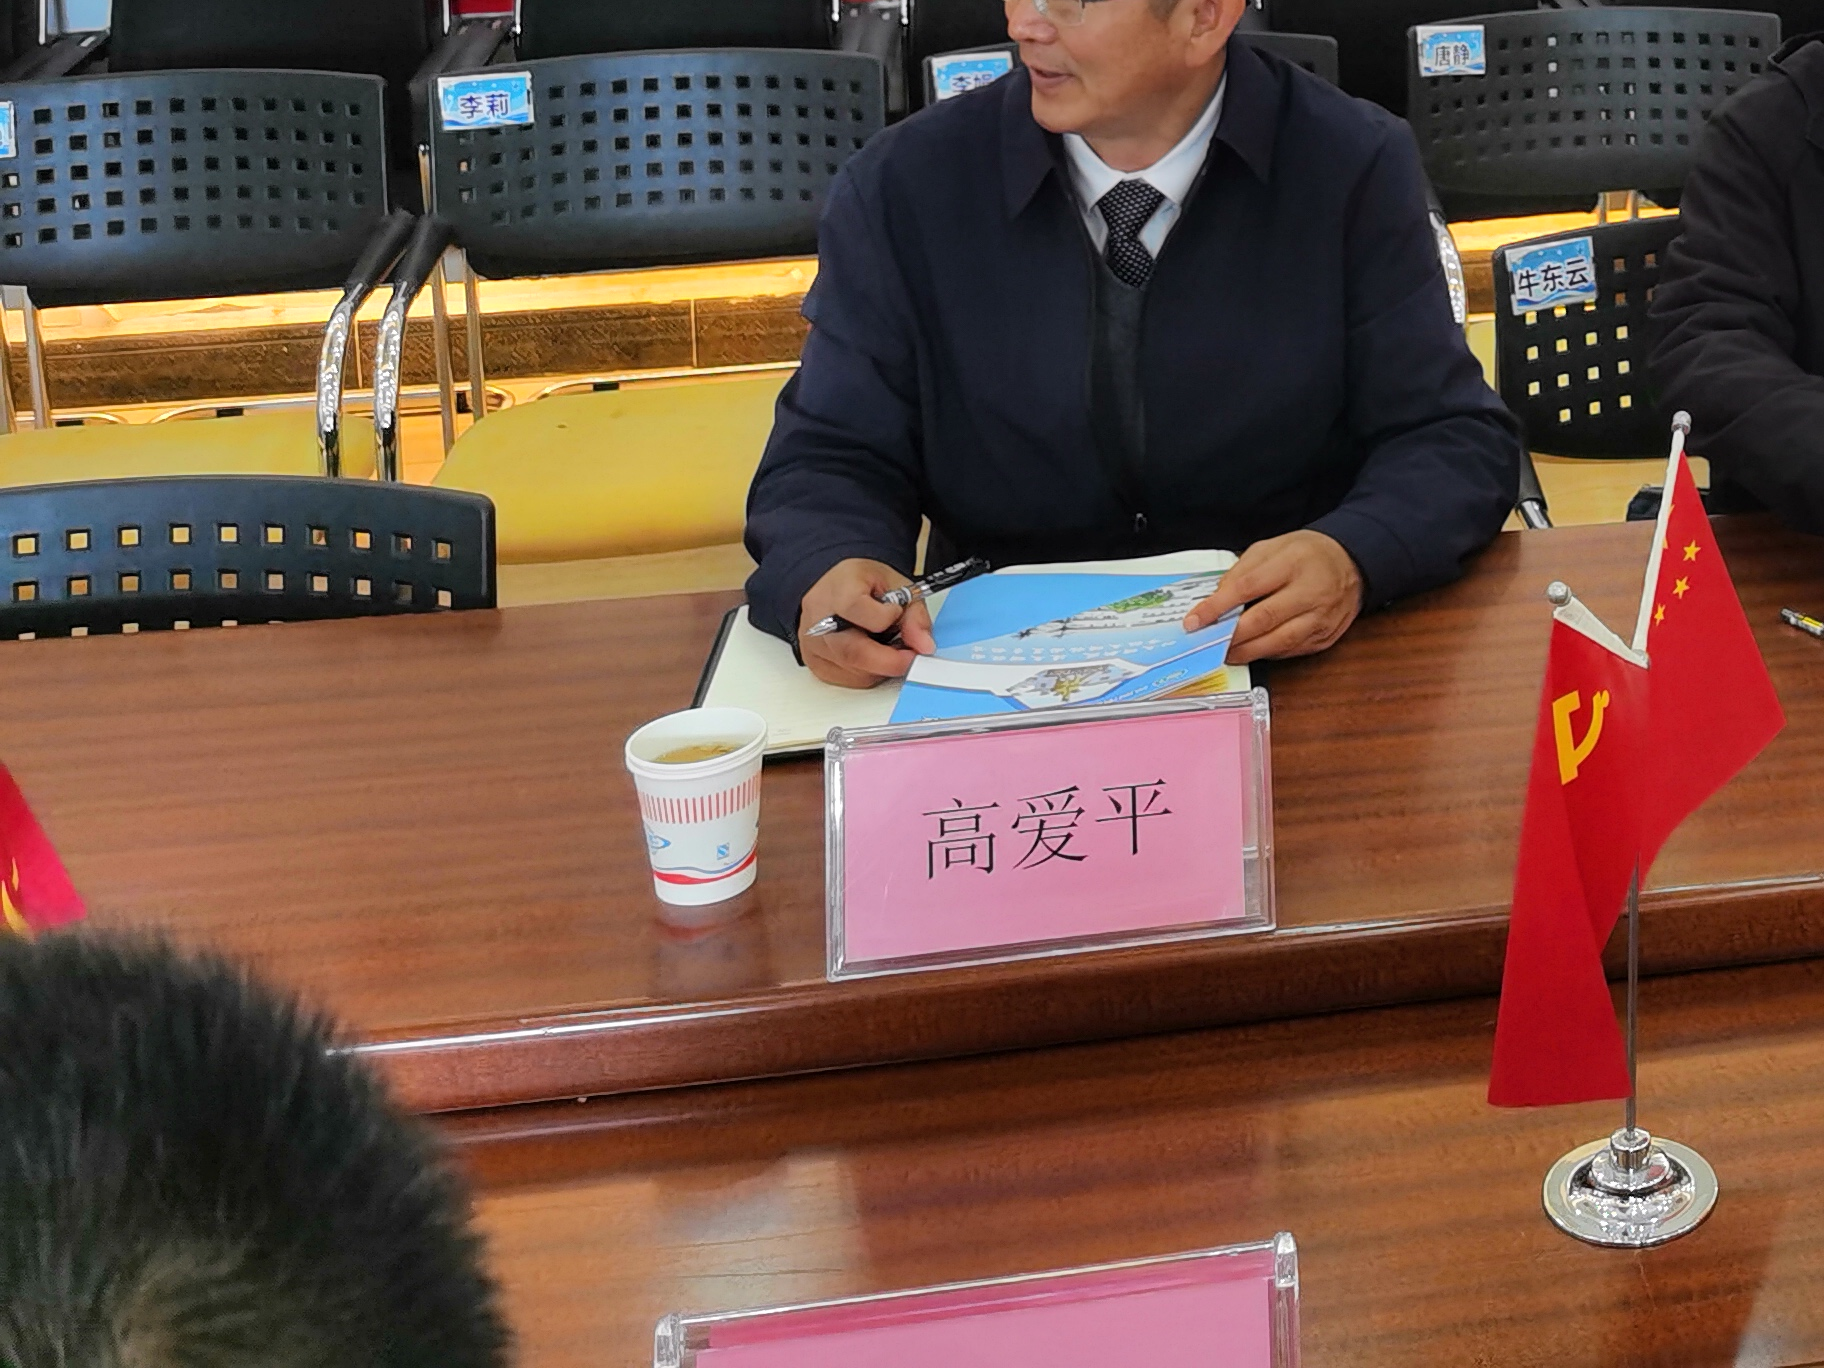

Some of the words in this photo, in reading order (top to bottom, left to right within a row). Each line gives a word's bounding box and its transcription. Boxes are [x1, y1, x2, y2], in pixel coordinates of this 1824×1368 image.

[1432, 43, 1470, 68] 唐静
[458, 91, 510, 121] 李莉
[1514, 247, 1594, 296] 牛东云
[921, 777, 1173, 882] 高爱平
